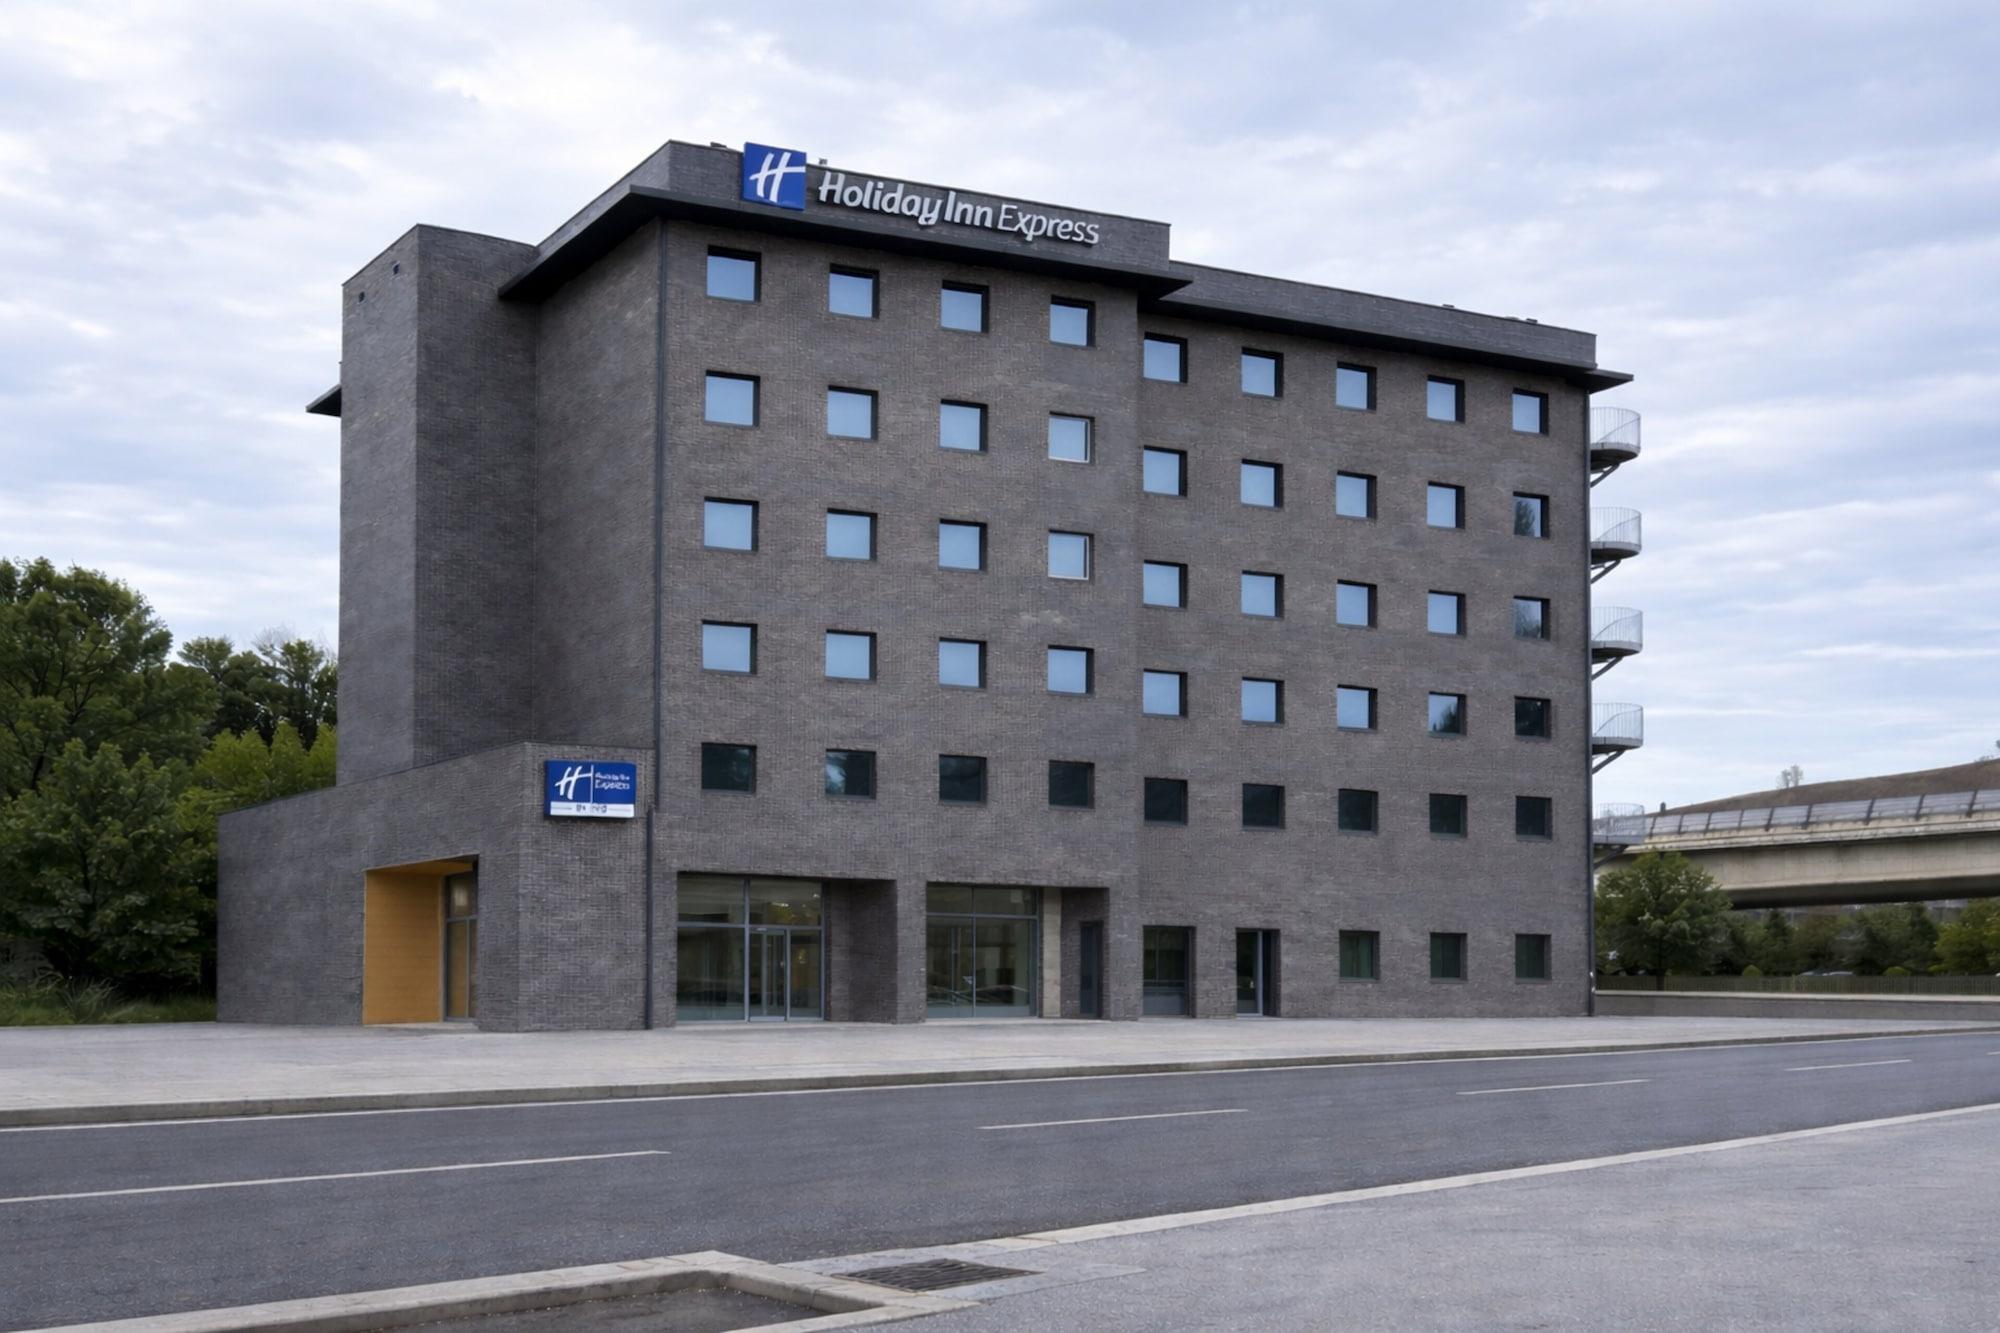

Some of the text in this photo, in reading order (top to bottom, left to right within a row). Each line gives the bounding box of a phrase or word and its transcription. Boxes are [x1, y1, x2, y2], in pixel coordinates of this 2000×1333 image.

[750, 152, 806, 203] H
[819, 171, 1100, 245] Holiday Inn Express
